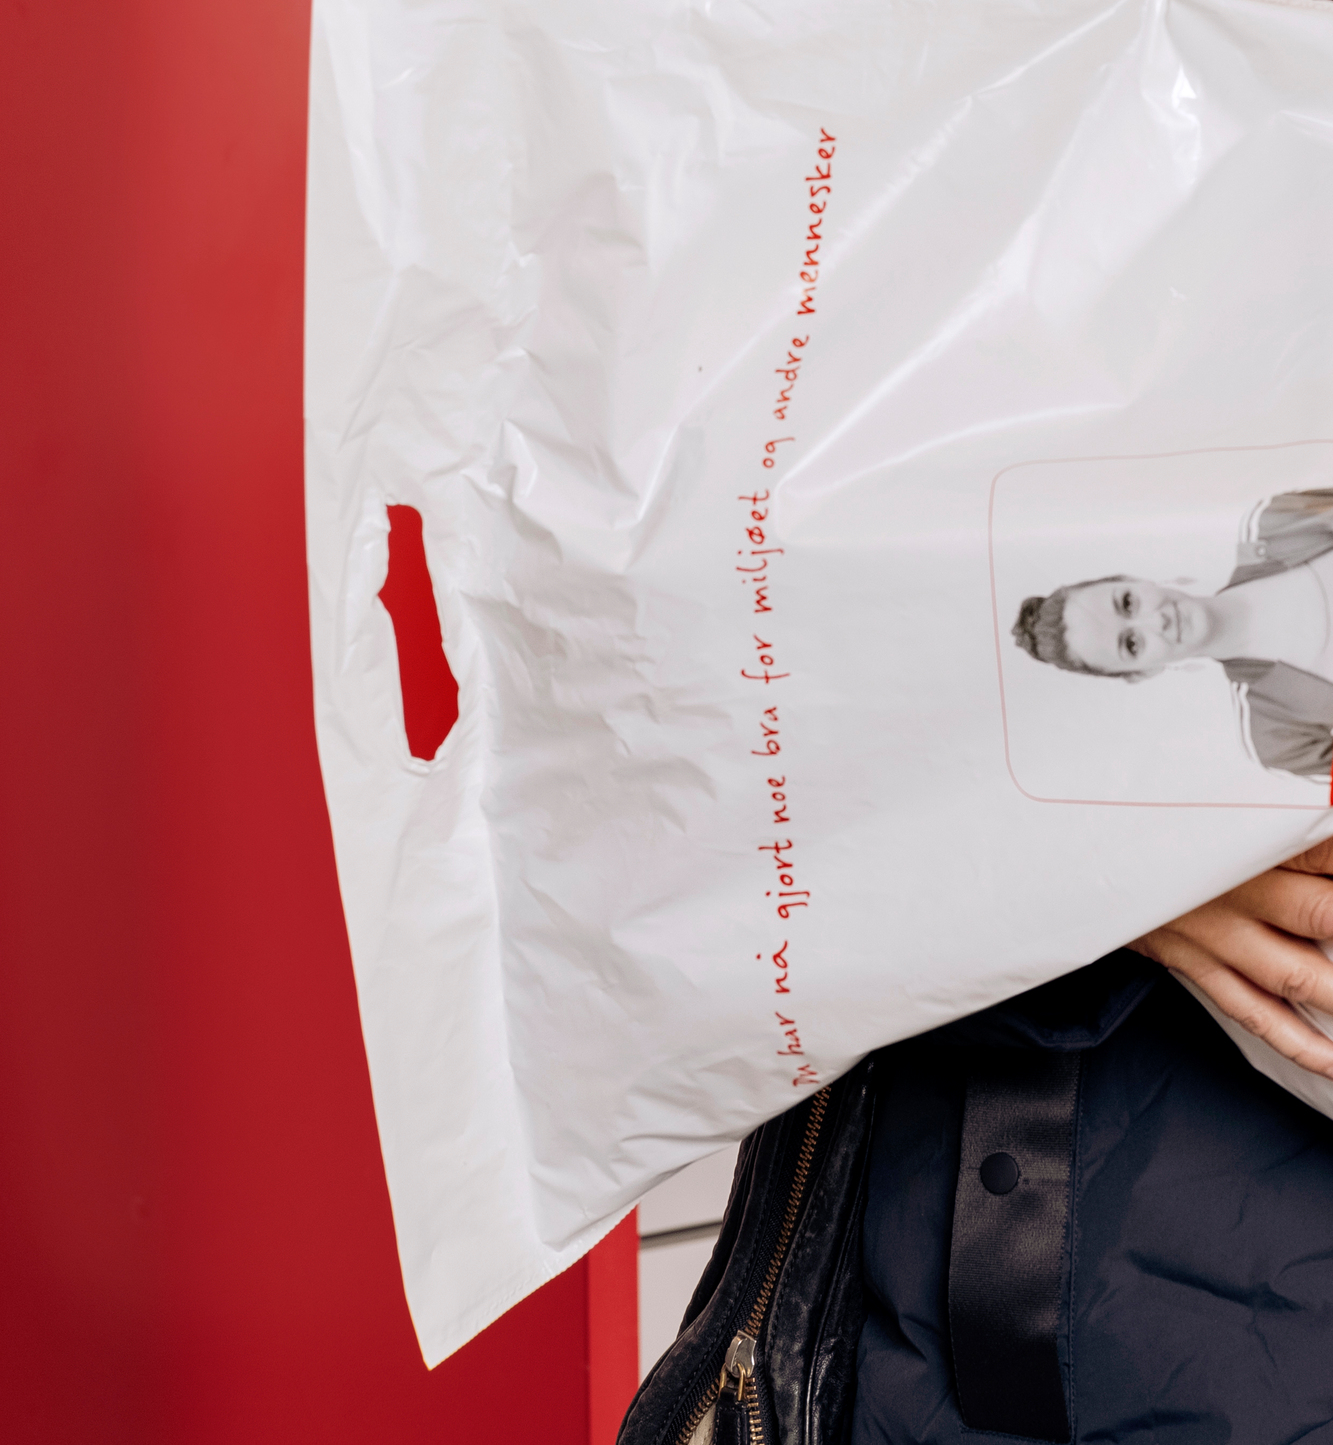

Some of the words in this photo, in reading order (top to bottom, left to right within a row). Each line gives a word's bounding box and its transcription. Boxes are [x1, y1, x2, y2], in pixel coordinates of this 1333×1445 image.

[797, 126, 837, 316] mennesker
[773, 335, 810, 420] andre
[762, 436, 796, 469] og
[736, 488, 785, 614] miljøet
[740, 633, 791, 684] for
[751, 706, 782, 756] bra
[767, 775, 791, 824] noe
[758, 839, 811, 920] gjort
[756, 940, 791, 995] nå
